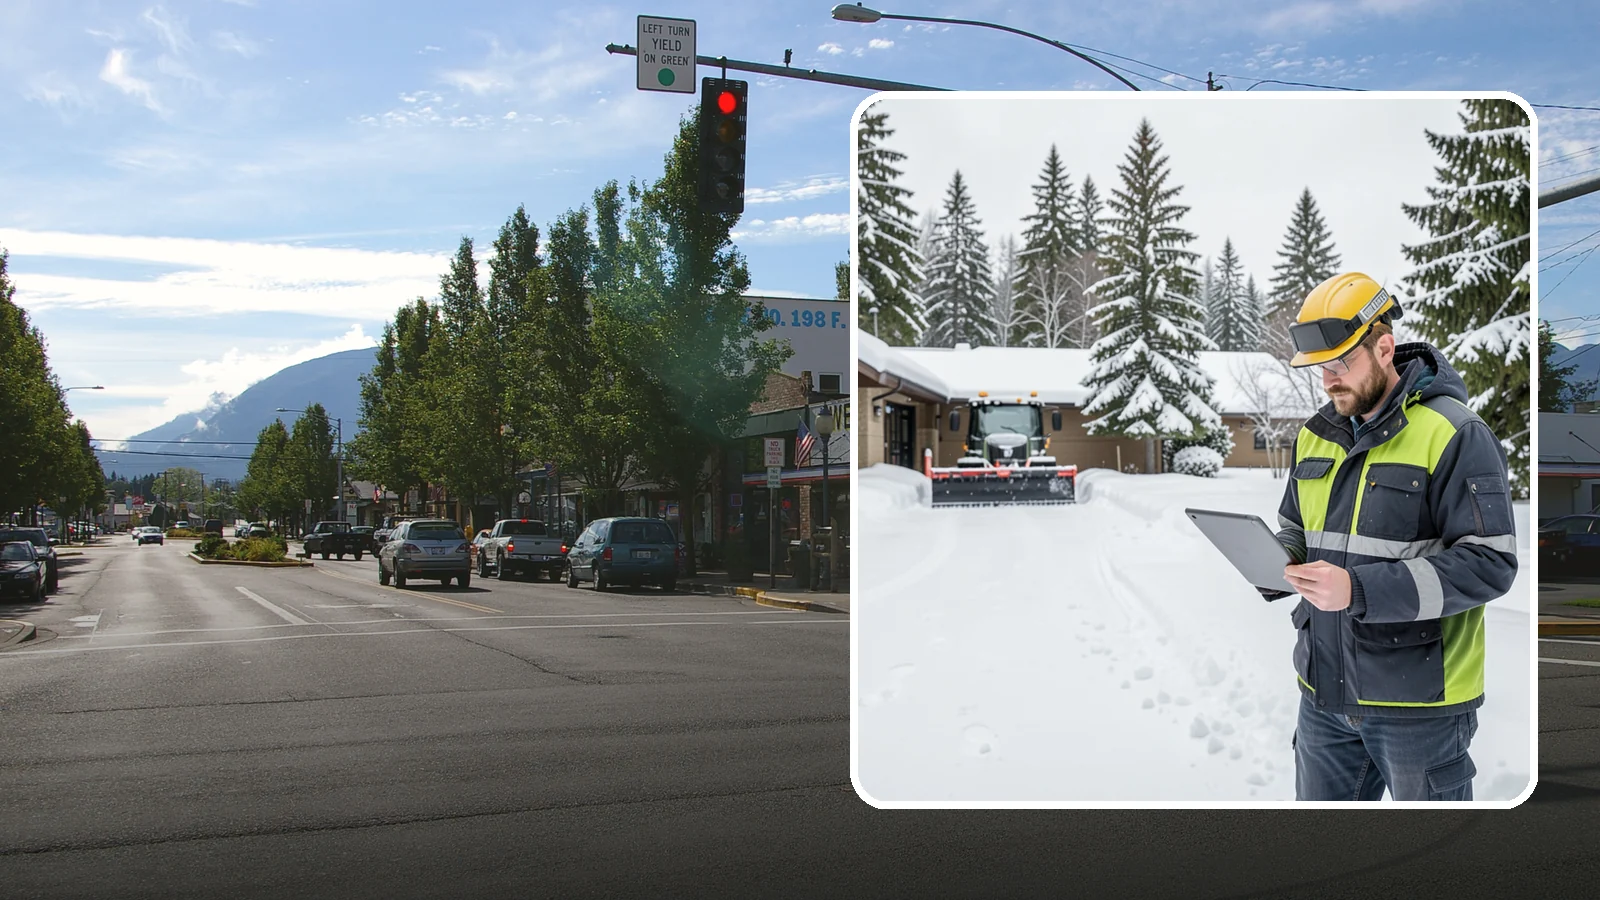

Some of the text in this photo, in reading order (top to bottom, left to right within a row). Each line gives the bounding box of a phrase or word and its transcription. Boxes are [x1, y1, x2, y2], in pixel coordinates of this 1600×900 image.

[643, 24, 690, 36] LEFT TURN
[652, 38, 682, 52] YIELD
[644, 53, 689, 66] ON GREEN
[791, 309, 826, 328] 198
[831, 311, 847, 329] F.
